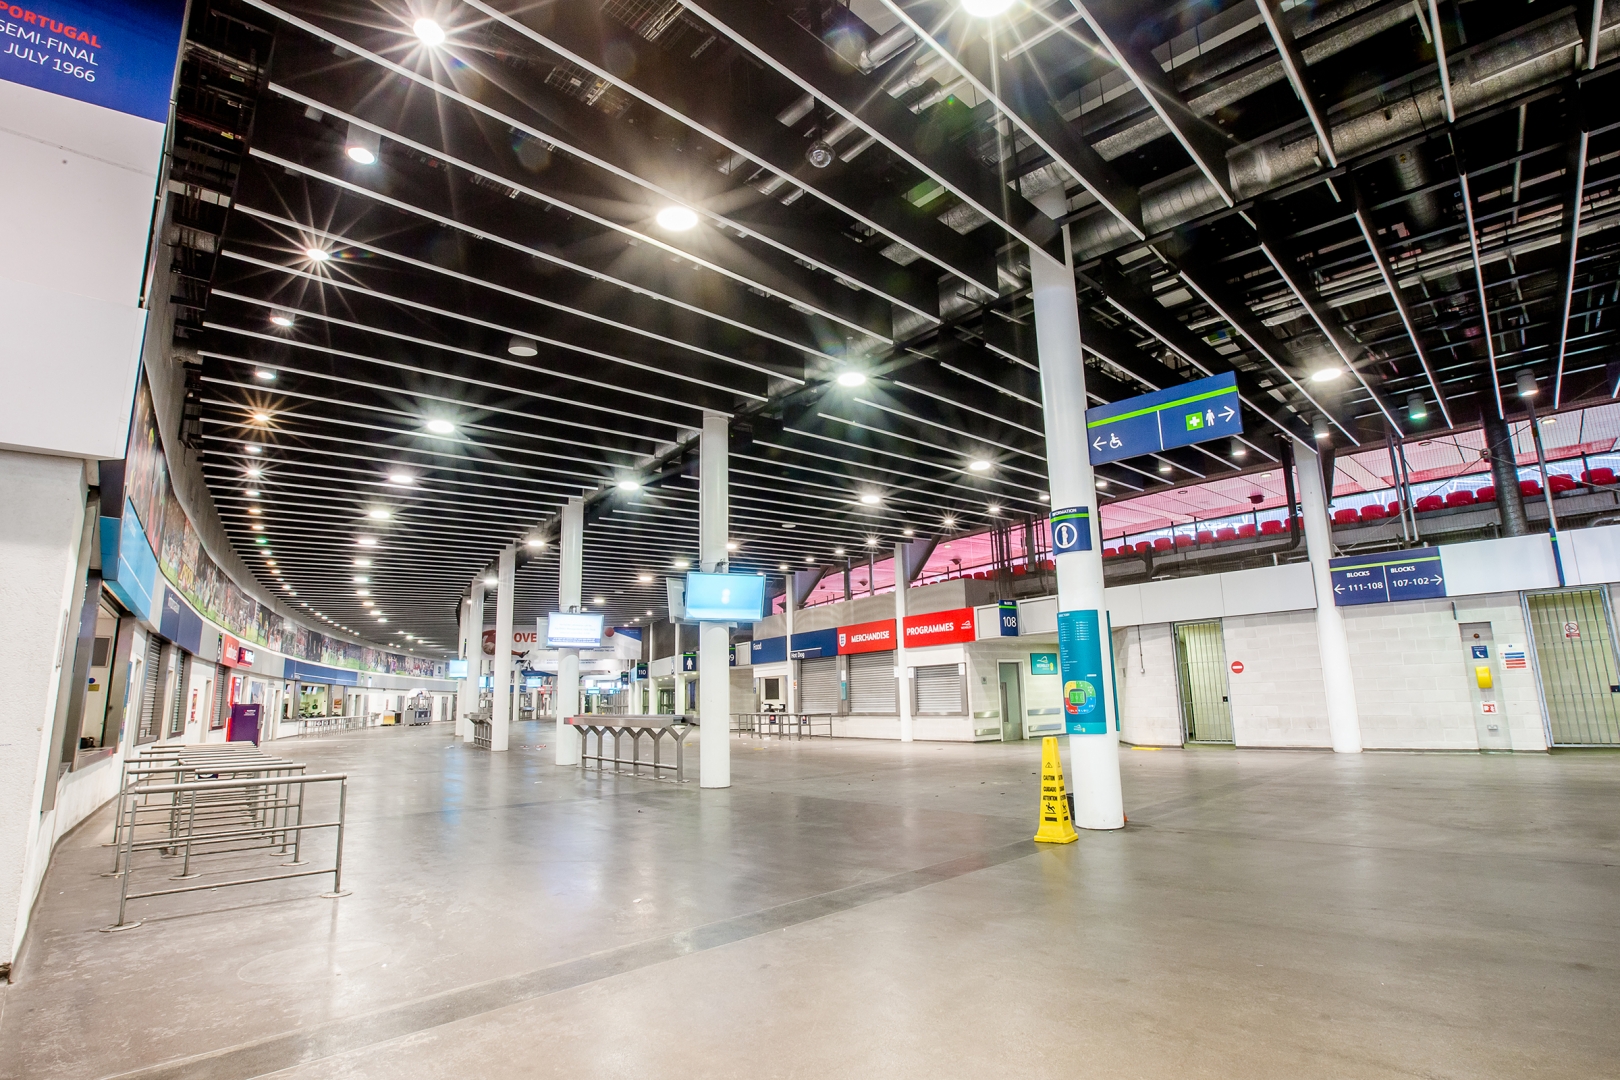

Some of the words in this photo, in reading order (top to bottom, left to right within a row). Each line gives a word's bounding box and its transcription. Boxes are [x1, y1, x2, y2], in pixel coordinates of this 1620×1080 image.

[0, 0, 101, 49] PORTUGAL
[4, 42, 49, 65] JULY
[52, 58, 96, 82] 1966
[1348, 582, 1383, 591] 111-108
[1392, 578, 1429, 588] 107-102
[1002, 616, 1017, 628] 108
[906, 622, 954, 636] PROGRAMMES
[850, 630, 890, 643] MERCHANDISE
[752, 642, 762, 650] Food
